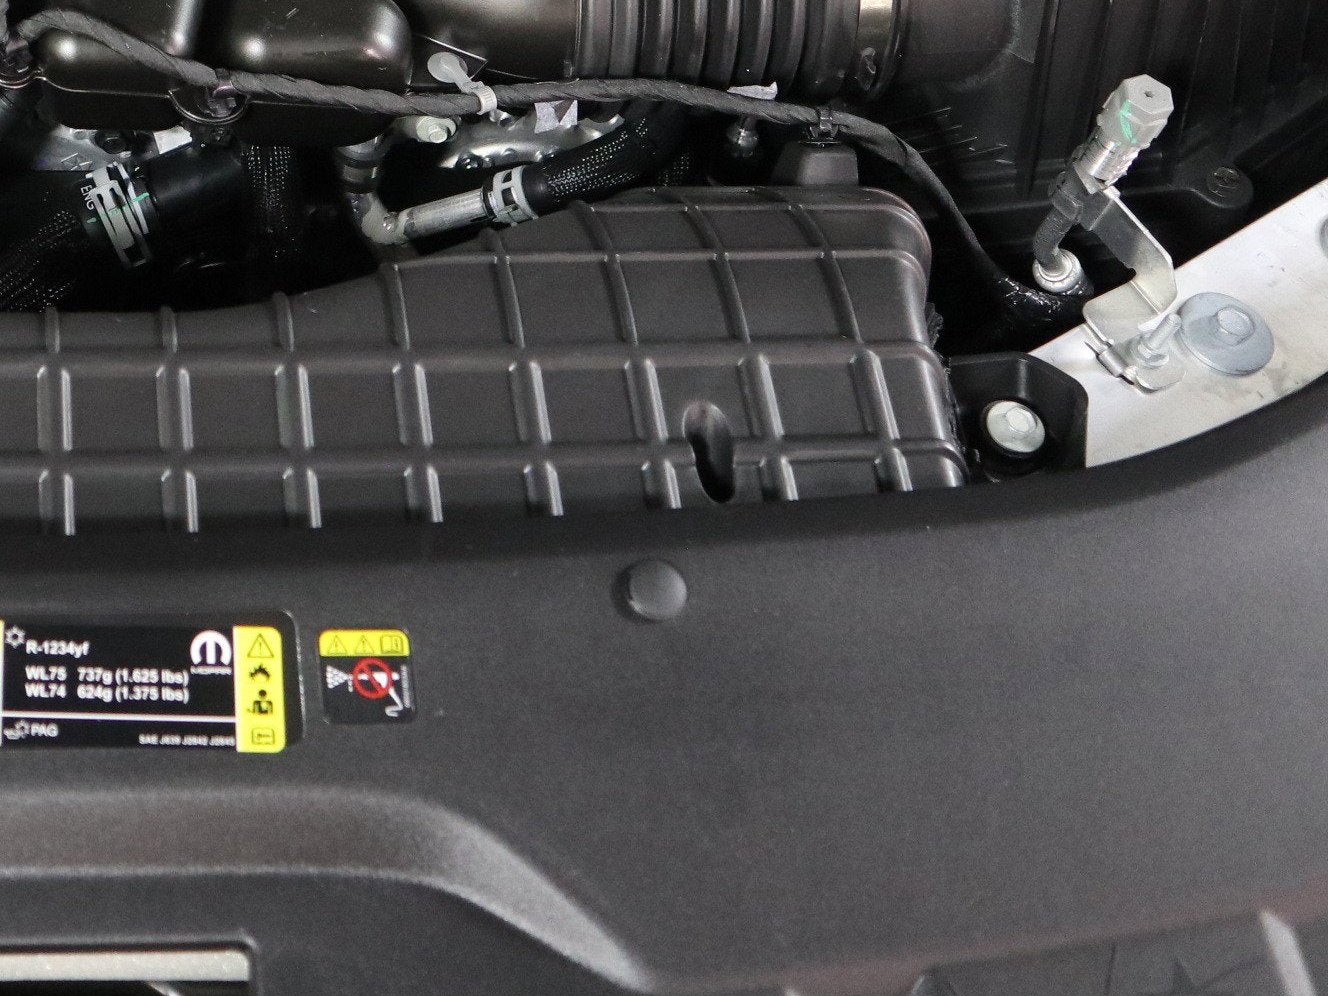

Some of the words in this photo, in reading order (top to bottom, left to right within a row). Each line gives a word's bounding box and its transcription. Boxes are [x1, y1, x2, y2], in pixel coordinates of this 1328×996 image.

[25, 639, 90, 659] R-1234yf
[25, 664, 67, 681] WL75
[77, 666, 113, 685] 737g
[115, 667, 159, 686] (1.625
[161, 668, 190, 687] lbs)
[24, 682, 67, 698] WL74
[76, 683, 113, 703] 624g
[115, 685, 159, 704] (1.375
[161, 686, 190, 705] lbs)
[30, 722, 59, 738] PAG
